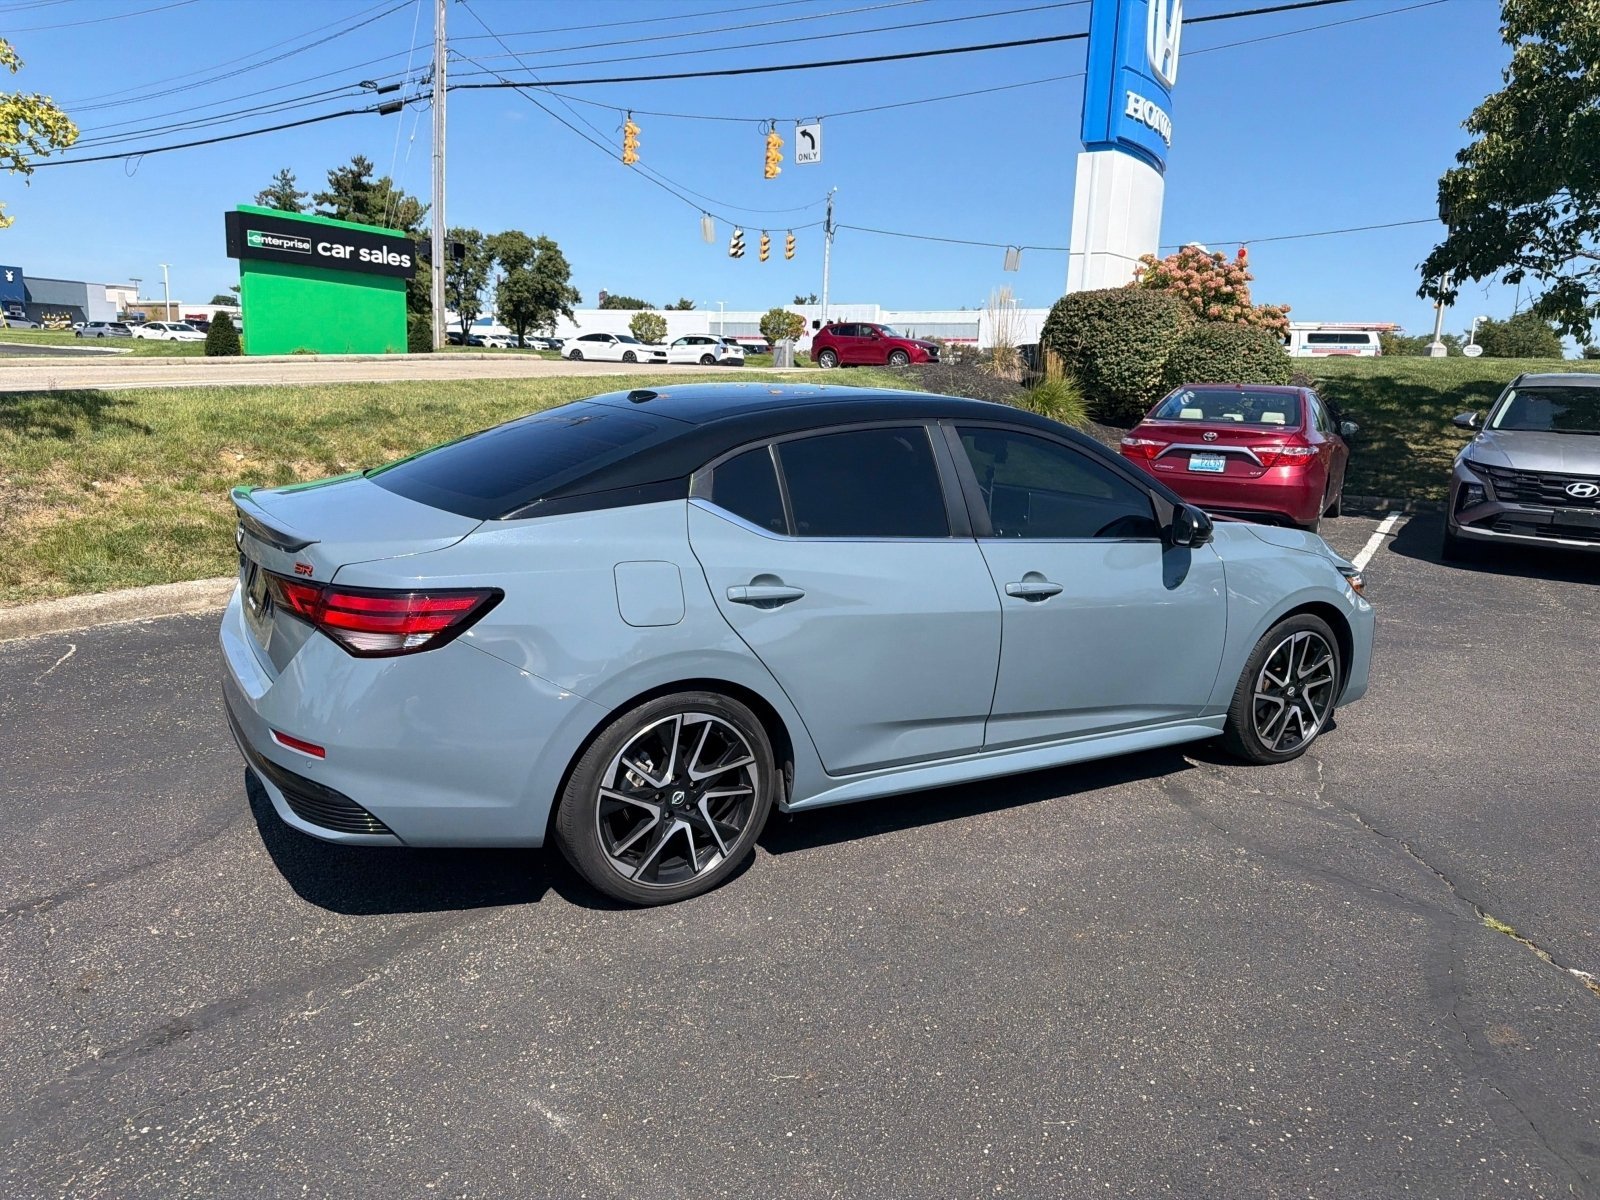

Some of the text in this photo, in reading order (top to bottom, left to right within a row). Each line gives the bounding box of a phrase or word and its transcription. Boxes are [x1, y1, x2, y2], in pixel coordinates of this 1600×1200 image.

[798, 152, 818, 161] ONLY
[251, 234, 411, 268] enterprise car sales
[295, 562, 313, 577] SR
